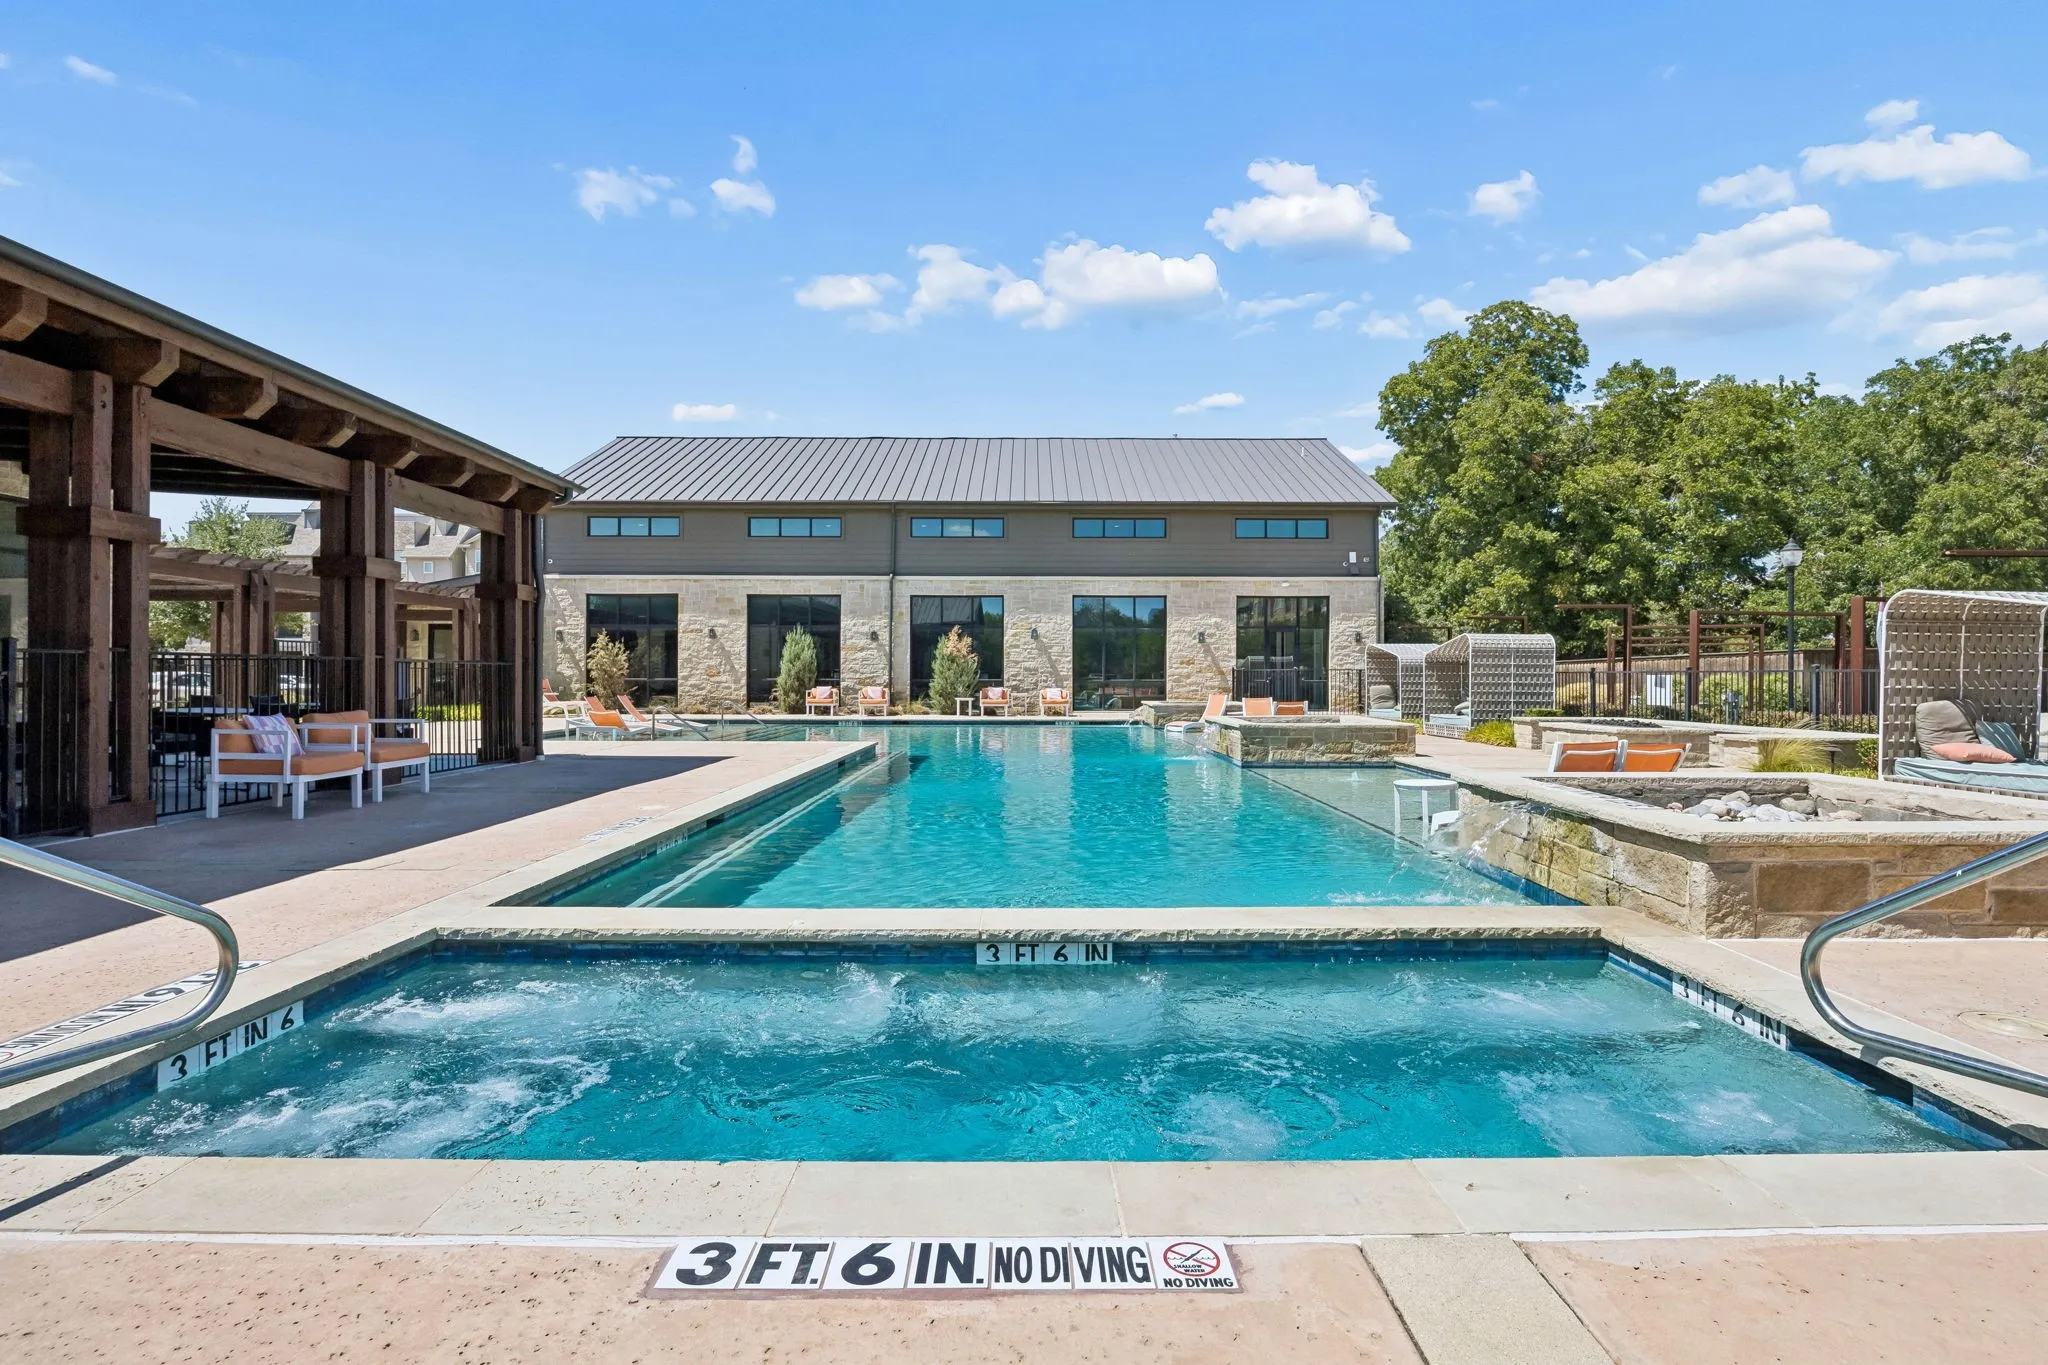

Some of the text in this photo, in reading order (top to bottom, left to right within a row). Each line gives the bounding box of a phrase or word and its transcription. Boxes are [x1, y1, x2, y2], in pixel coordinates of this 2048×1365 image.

[986, 944, 1107, 962] 3 FT 6 IN
[1678, 976, 1690, 999] 3
[1732, 1004, 1745, 1026] 6
[1760, 1013, 1781, 1045] IN
[170, 1006, 295, 1082] 3 FT IN 6
[676, 1242, 737, 1286] 3
[744, 1243, 831, 1285] FT.
[840, 1242, 895, 1286] 6
[914, 1243, 985, 1285] IN.
[994, 1246, 1033, 1284] NO
[1163, 1277, 1234, 1288] NO DIVING
